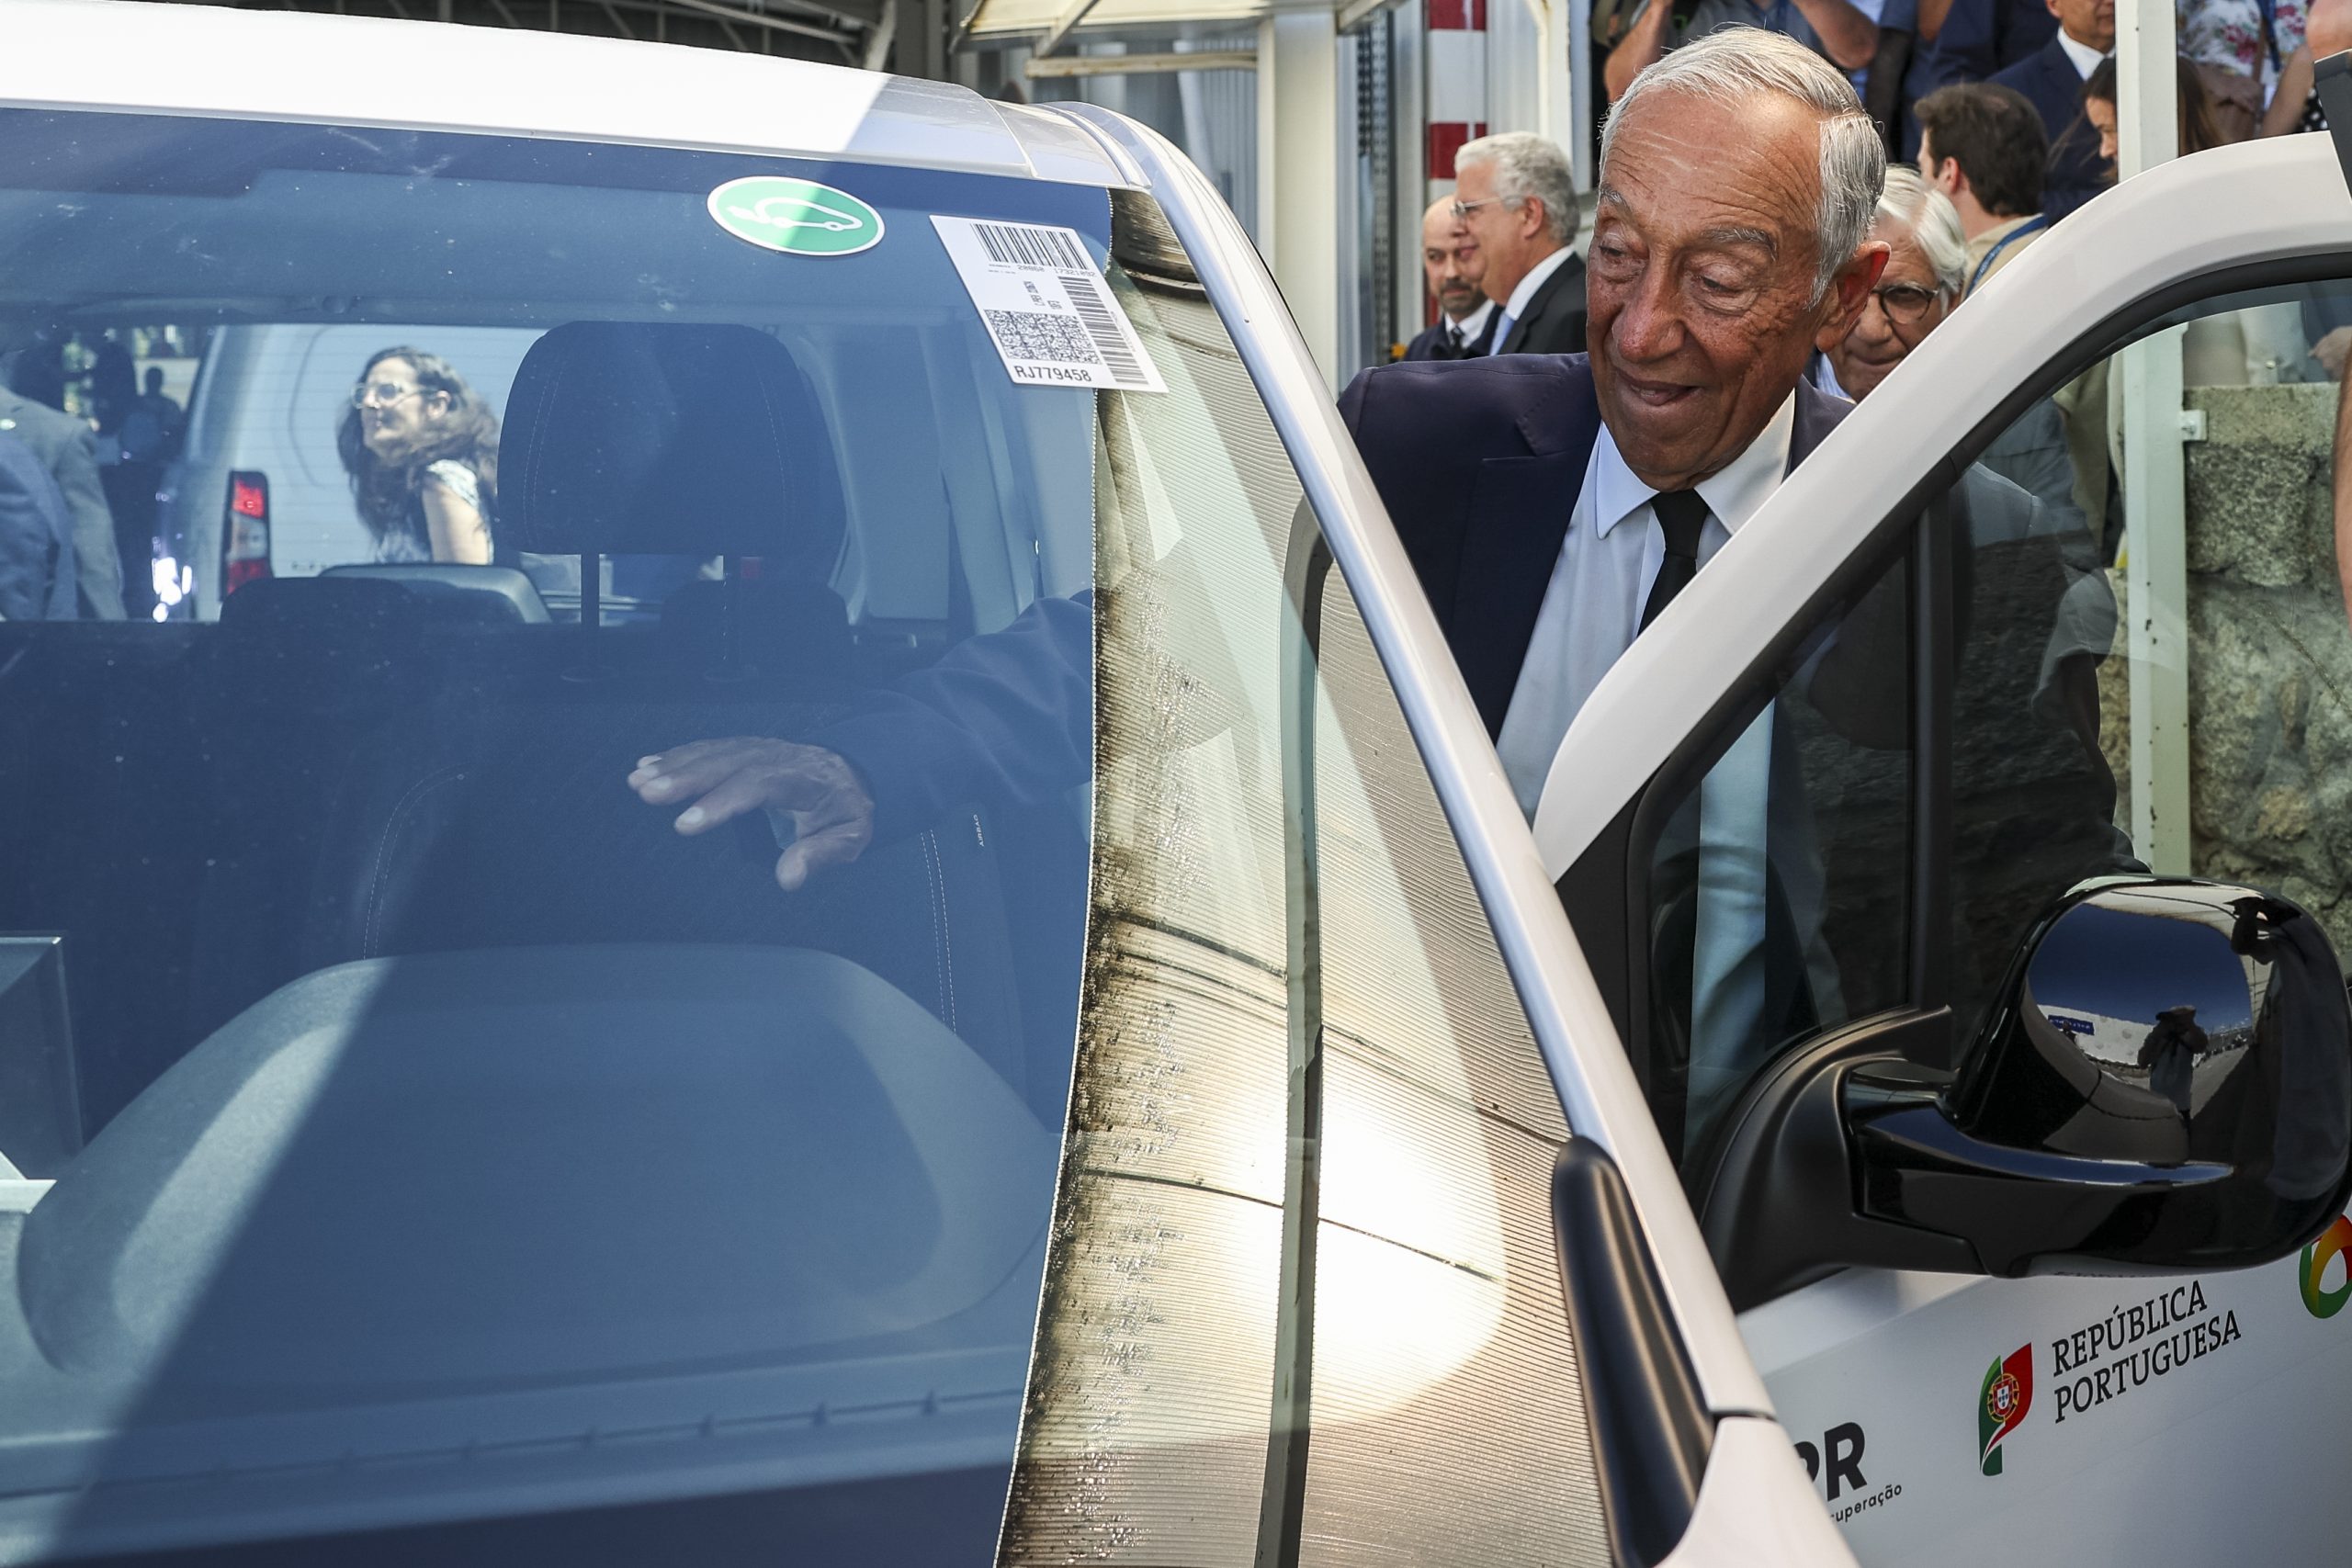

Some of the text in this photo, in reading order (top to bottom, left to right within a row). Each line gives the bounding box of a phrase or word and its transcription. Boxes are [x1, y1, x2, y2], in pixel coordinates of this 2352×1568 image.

[1014, 366, 1091, 382] RJ779458
[2052, 1280, 2208, 1378] REPÚBLICA
[2054, 1310, 2242, 1424] PORTUGUESA
